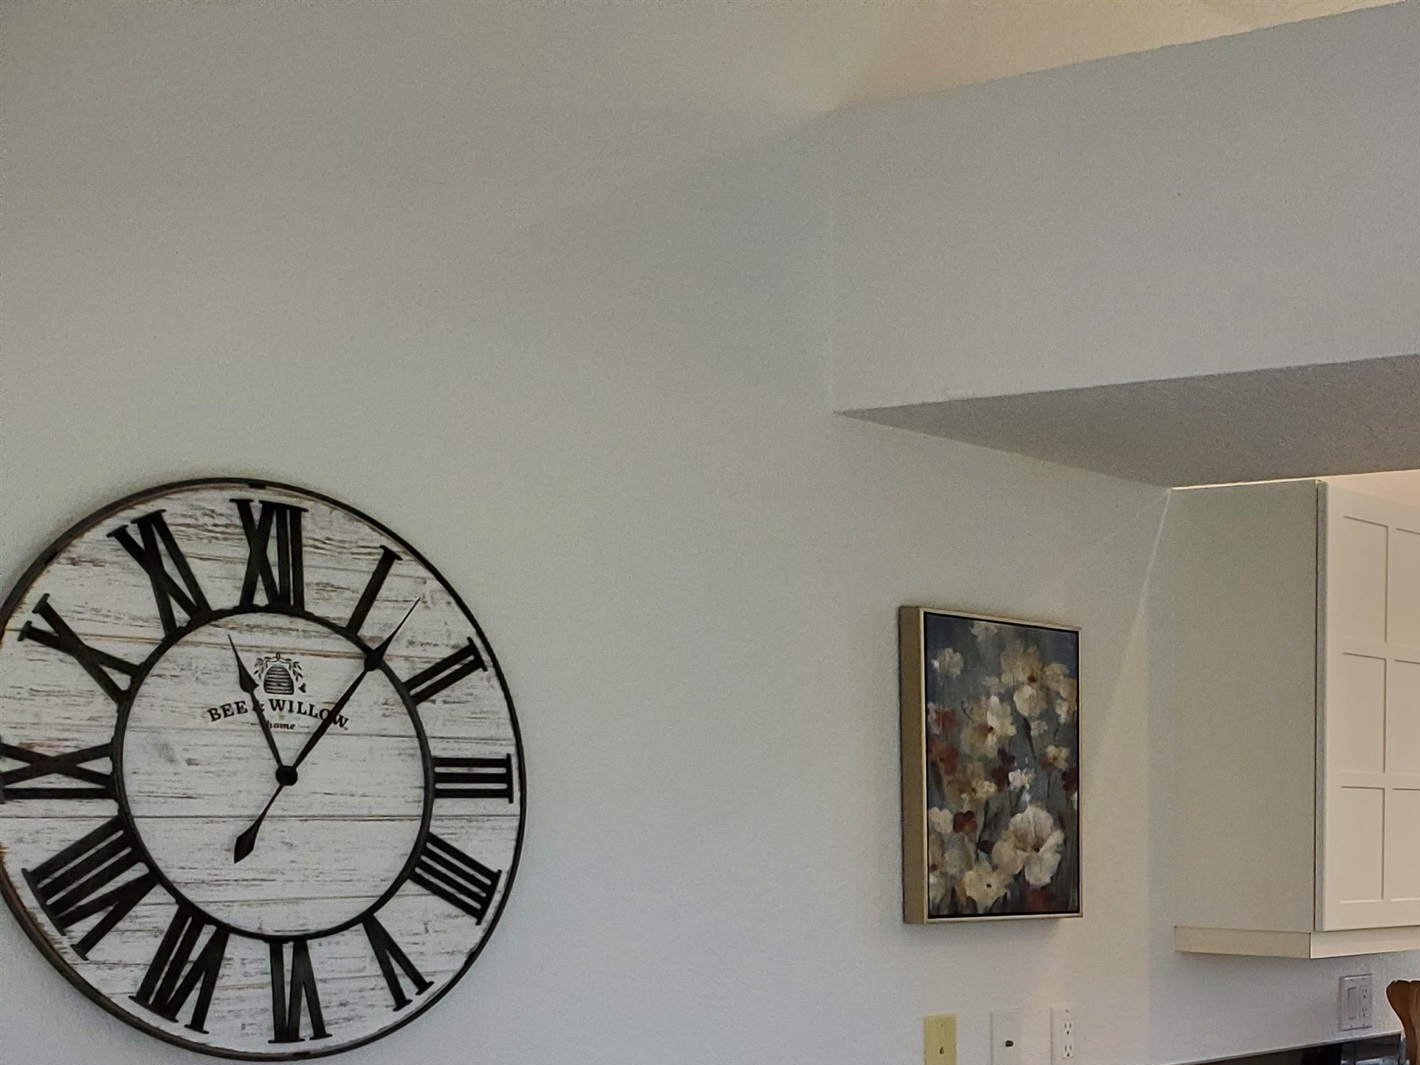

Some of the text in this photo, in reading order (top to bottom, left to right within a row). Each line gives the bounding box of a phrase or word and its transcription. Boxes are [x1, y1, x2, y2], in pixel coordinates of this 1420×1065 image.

[107, 509, 212, 640] XI
[230, 498, 309, 611] XII
[344, 545, 403, 637] I
[18, 593, 145, 705] X
[401, 637, 487, 706] II
[207, 700, 249, 722] BEE
[267, 698, 350, 728] WILLOW
[266, 720, 296, 730] home
[433, 753, 513, 804] III
[21, 812, 163, 960] VIII
[406, 831, 503, 925] IIII
[128, 905, 229, 1035] VII
[268, 937, 333, 1044] VI
[362, 913, 435, 1012] V
